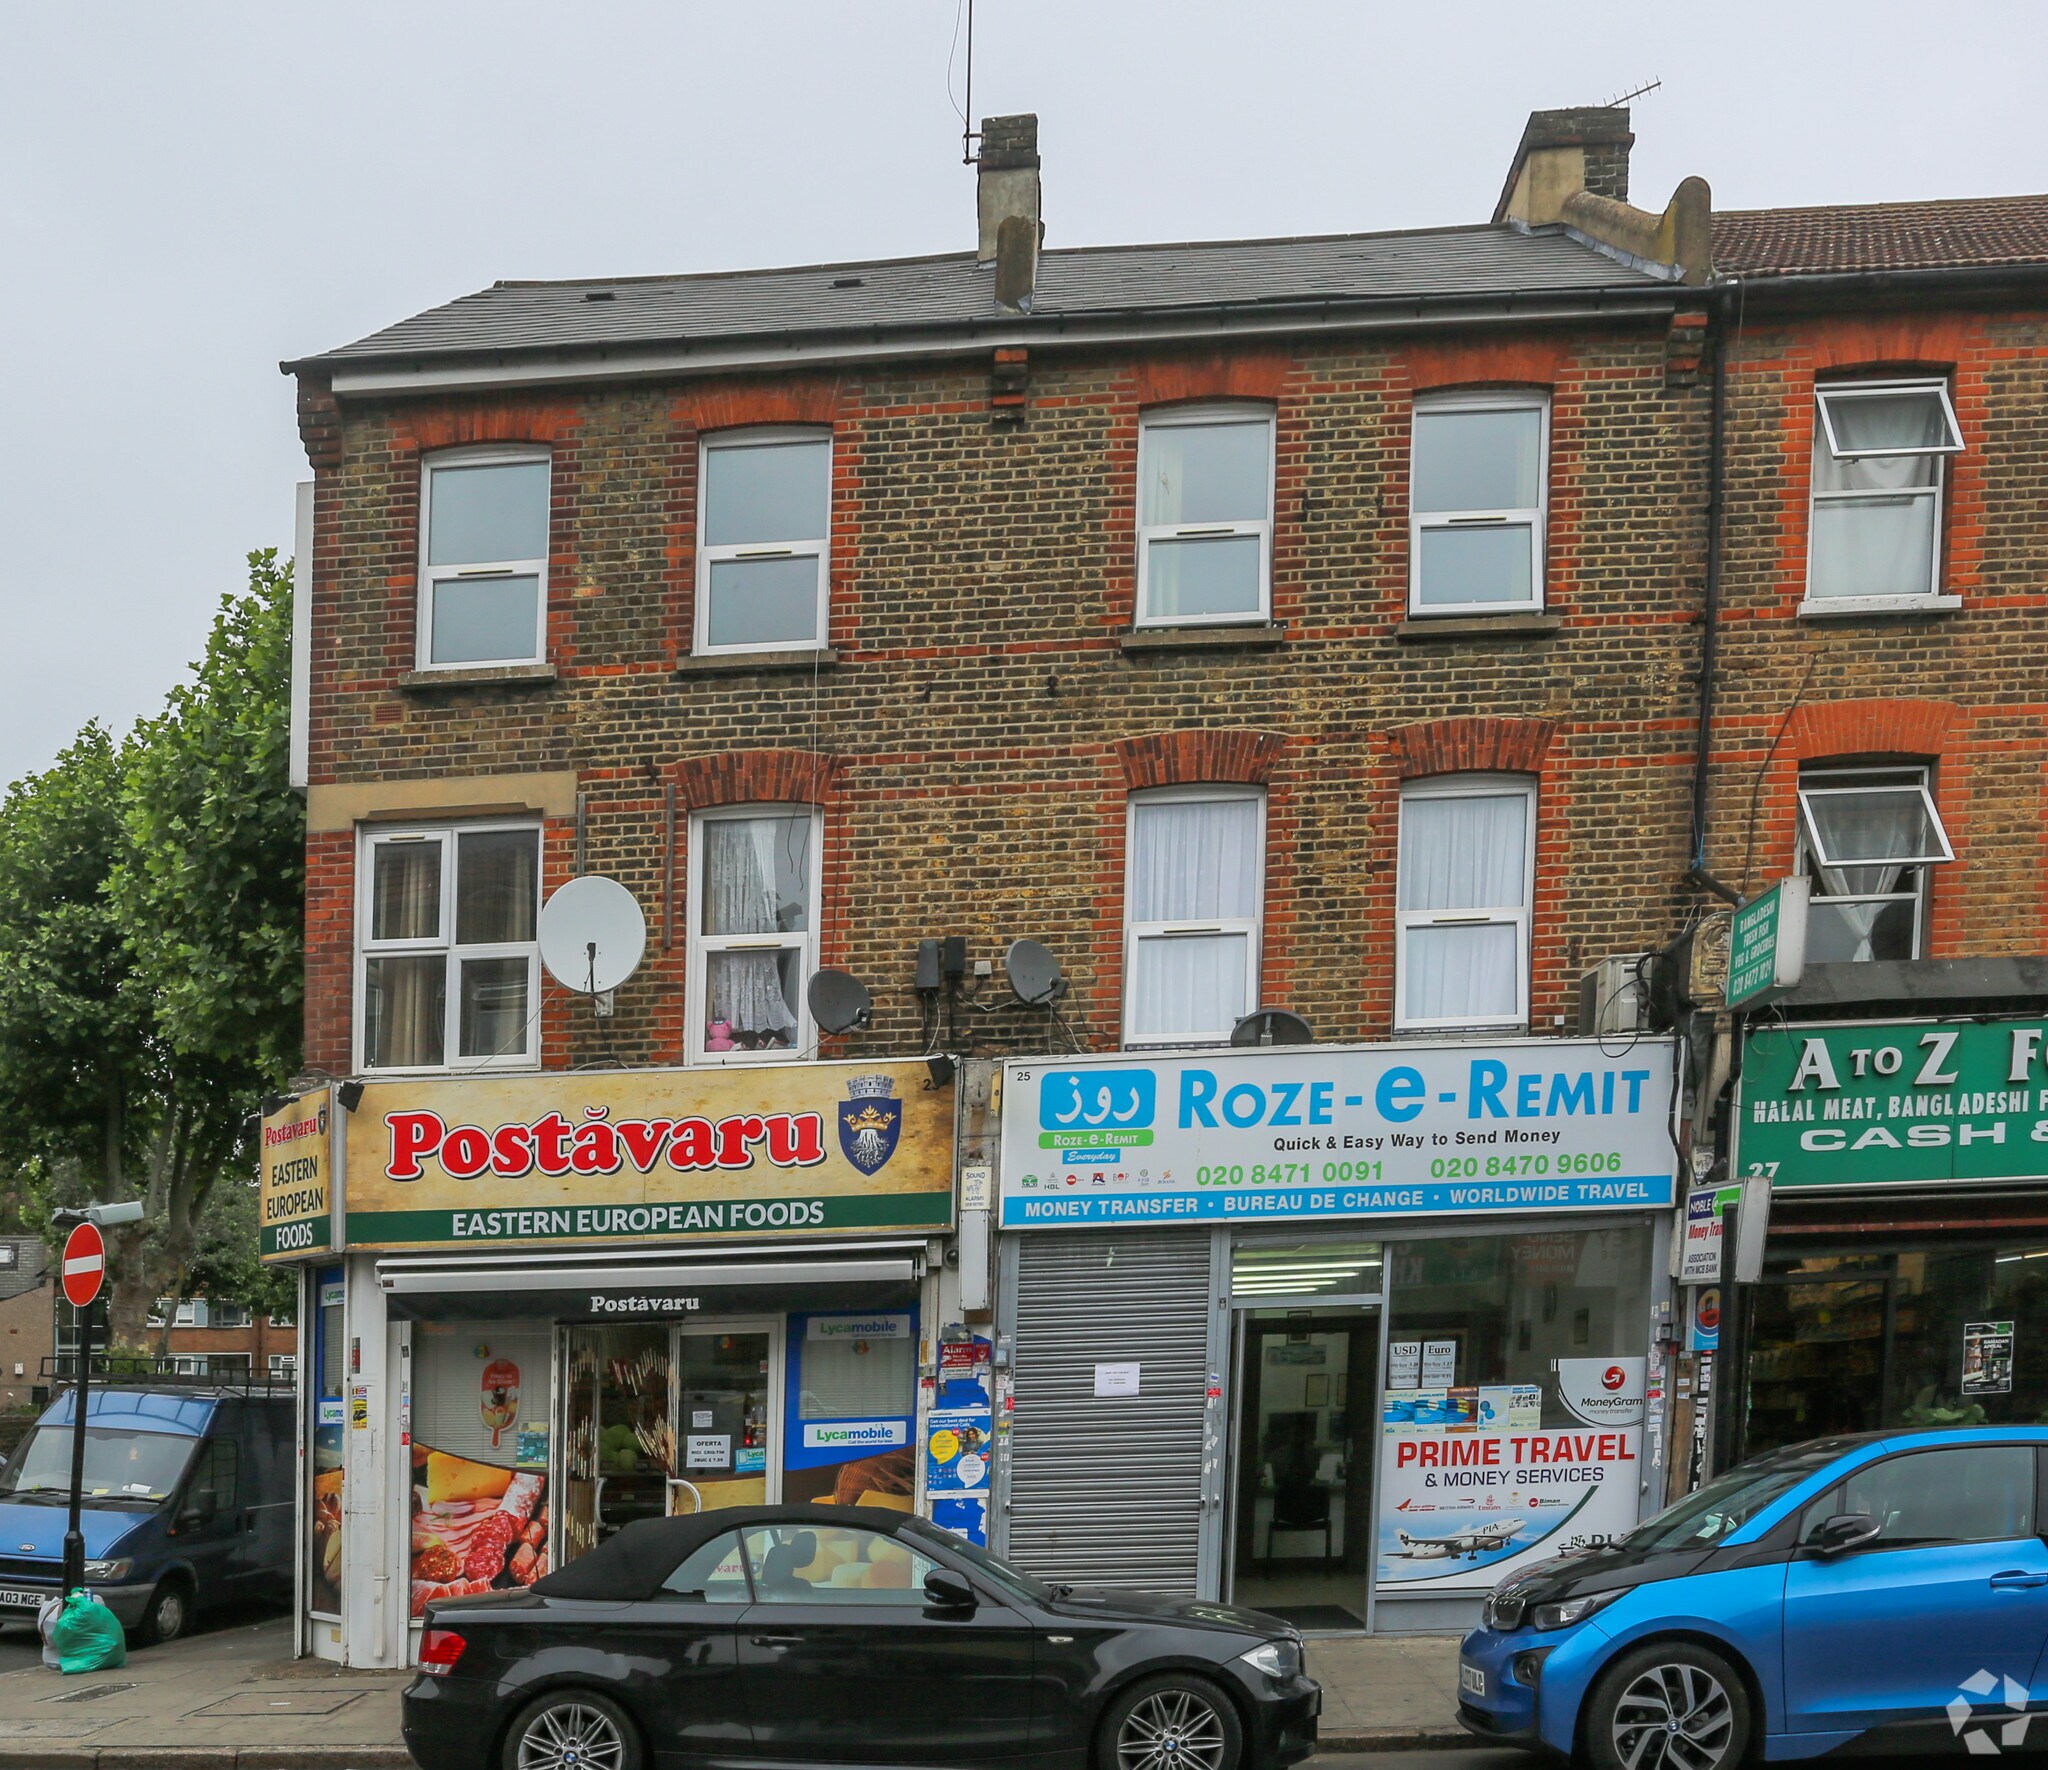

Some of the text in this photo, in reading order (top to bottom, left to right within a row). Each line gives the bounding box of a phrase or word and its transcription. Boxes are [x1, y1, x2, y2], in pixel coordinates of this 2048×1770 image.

[1740, 899, 1775, 934] BANGLADESHI
[1744, 920, 1769, 948] FRESH FISH
[1735, 952, 1744, 969] VEG
[1750, 933, 1775, 960] GROCERIES
[1787, 1038, 1842, 1091] A
[1913, 1032, 1960, 1085] Z
[2008, 1028, 2048, 1081] F
[1016, 1071, 1031, 1082] 25
[1055, 1076, 1140, 1125] روز
[1754, 1099, 1814, 1124] HALAL
[1823, 1097, 1882, 1122] MEAT,
[384, 1105, 826, 1181] Postăvaru
[1274, 1129, 1561, 1152] Quick & Easy Way to Send Money
[1800, 1122, 2006, 1151] CASH
[1067, 1150, 1116, 1162] Everyday
[272, 1156, 318, 1187] EASTERN
[1196, 1152, 1622, 1186] 020 8471 0091 020 8470 9606
[1748, 1161, 1781, 1178] 27
[266, 1187, 324, 1220] EUROPEAN
[1025, 1182, 1649, 1218] MONEY TRANSFER BUREAU DE CHANGE WORLDWIDE TRAVEL
[1690, 1199, 1712, 1214] NOBLE
[452, 1201, 824, 1236] EASTERN EUROPEAN FOODS
[276, 1222, 313, 1250] FOODS
[1688, 1224, 1709, 1241] Money
[1688, 1252, 1717, 1264] ASSOCIATION
[1705, 1263, 1718, 1274] BANK
[590, 1295, 700, 1312] Postăvaru
[943, 1346, 972, 1354] Alarm
[1394, 1346, 1417, 1355] USD
[1428, 1345, 1451, 1354] Euro
[1581, 1397, 1643, 1408] MoneyGram
[816, 1427, 893, 1442] Lycamobile
[1398, 1434, 1636, 1468] PRIME TRAVEL
[1425, 1467, 1604, 1488] & MONEY SERVICES
[1478, 1504, 1502, 1512] Emirates
[1483, 1523, 1499, 1535] PIA
[20, 1594, 42, 1606] MGE
